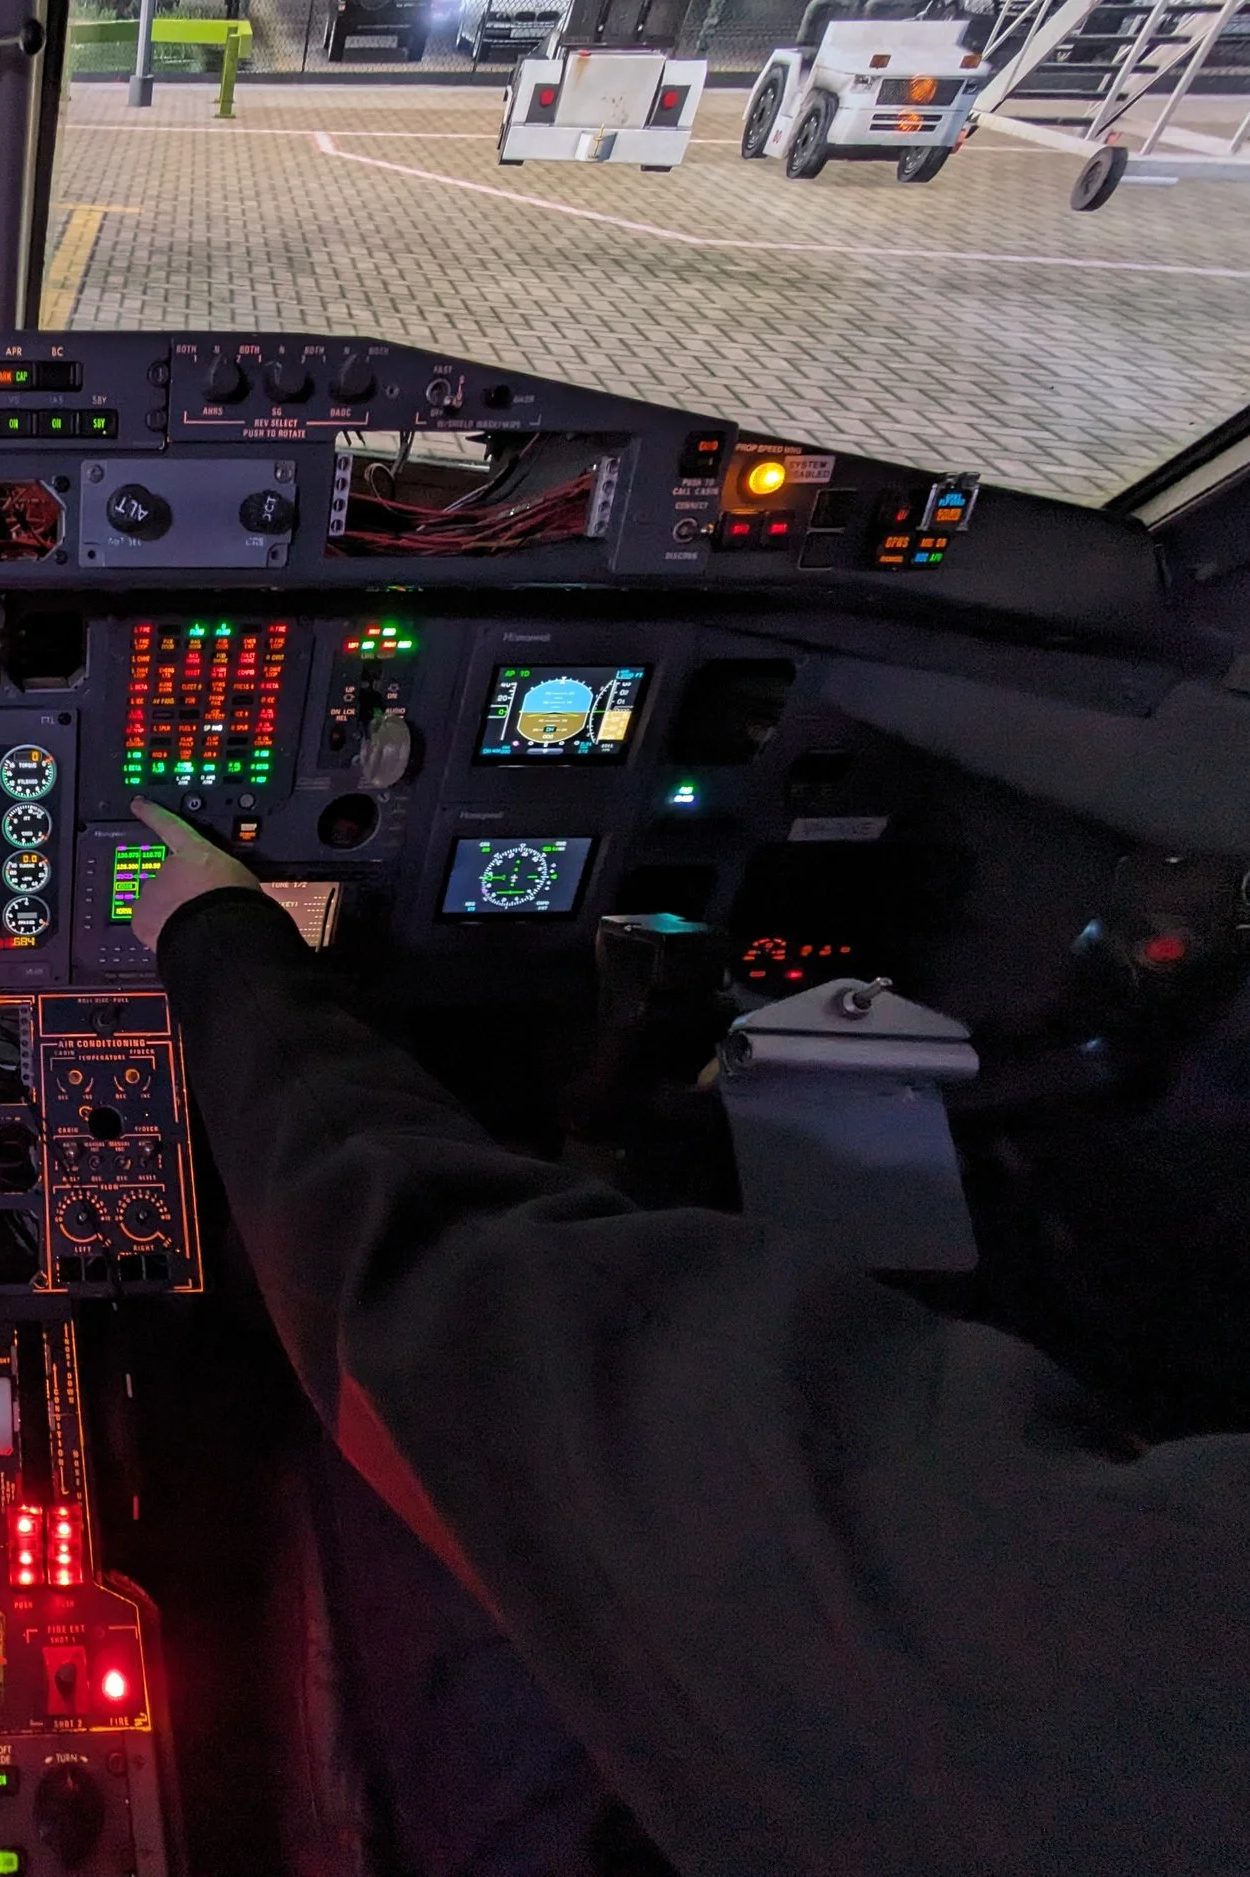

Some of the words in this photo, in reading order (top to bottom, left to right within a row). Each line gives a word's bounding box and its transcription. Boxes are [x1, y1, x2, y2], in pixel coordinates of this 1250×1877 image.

[6, 347, 22, 356] APR
[52, 347, 63, 356] BC
[239, 346, 260, 354] BOTH
[0, 372, 11, 381] ARM
[16, 371, 27, 381] CAP
[203, 407, 223, 416] AHRS
[271, 407, 282, 416] SG
[9, 419, 18, 428] ON
[52, 419, 61, 428] ON
[93, 418, 105, 429] SBY
[254, 419, 270, 427] REV
[271, 419, 298, 427] SELECT
[243, 429, 264, 438] PUSH
[267, 430, 276, 438] TO
[278, 429, 306, 438] ROTATE
[736, 444, 755, 452] PROP
[757, 445, 783, 454] SPEED
[672, 488, 690, 496] CALL
[115, 496, 149, 522] ALT
[31, 751, 39, 761] 0
[23, 855, 37, 863] 0.0
[58, 1040, 74, 1048] AIR
[77, 1039, 145, 1047] CONDITIONING
[54, 1388, 64, 1466] CONDITION
[14, 1601, 33, 1609] PUSH
[48, 1625, 66, 1634] FIRE
[70, 1624, 85, 1633] EXT
[50, 1636, 68, 1644] SHOT
[54, 1720, 74, 1728] SHOT
[110, 1717, 129, 1726] FIRE
[56, 1753, 78, 1763] TURN
